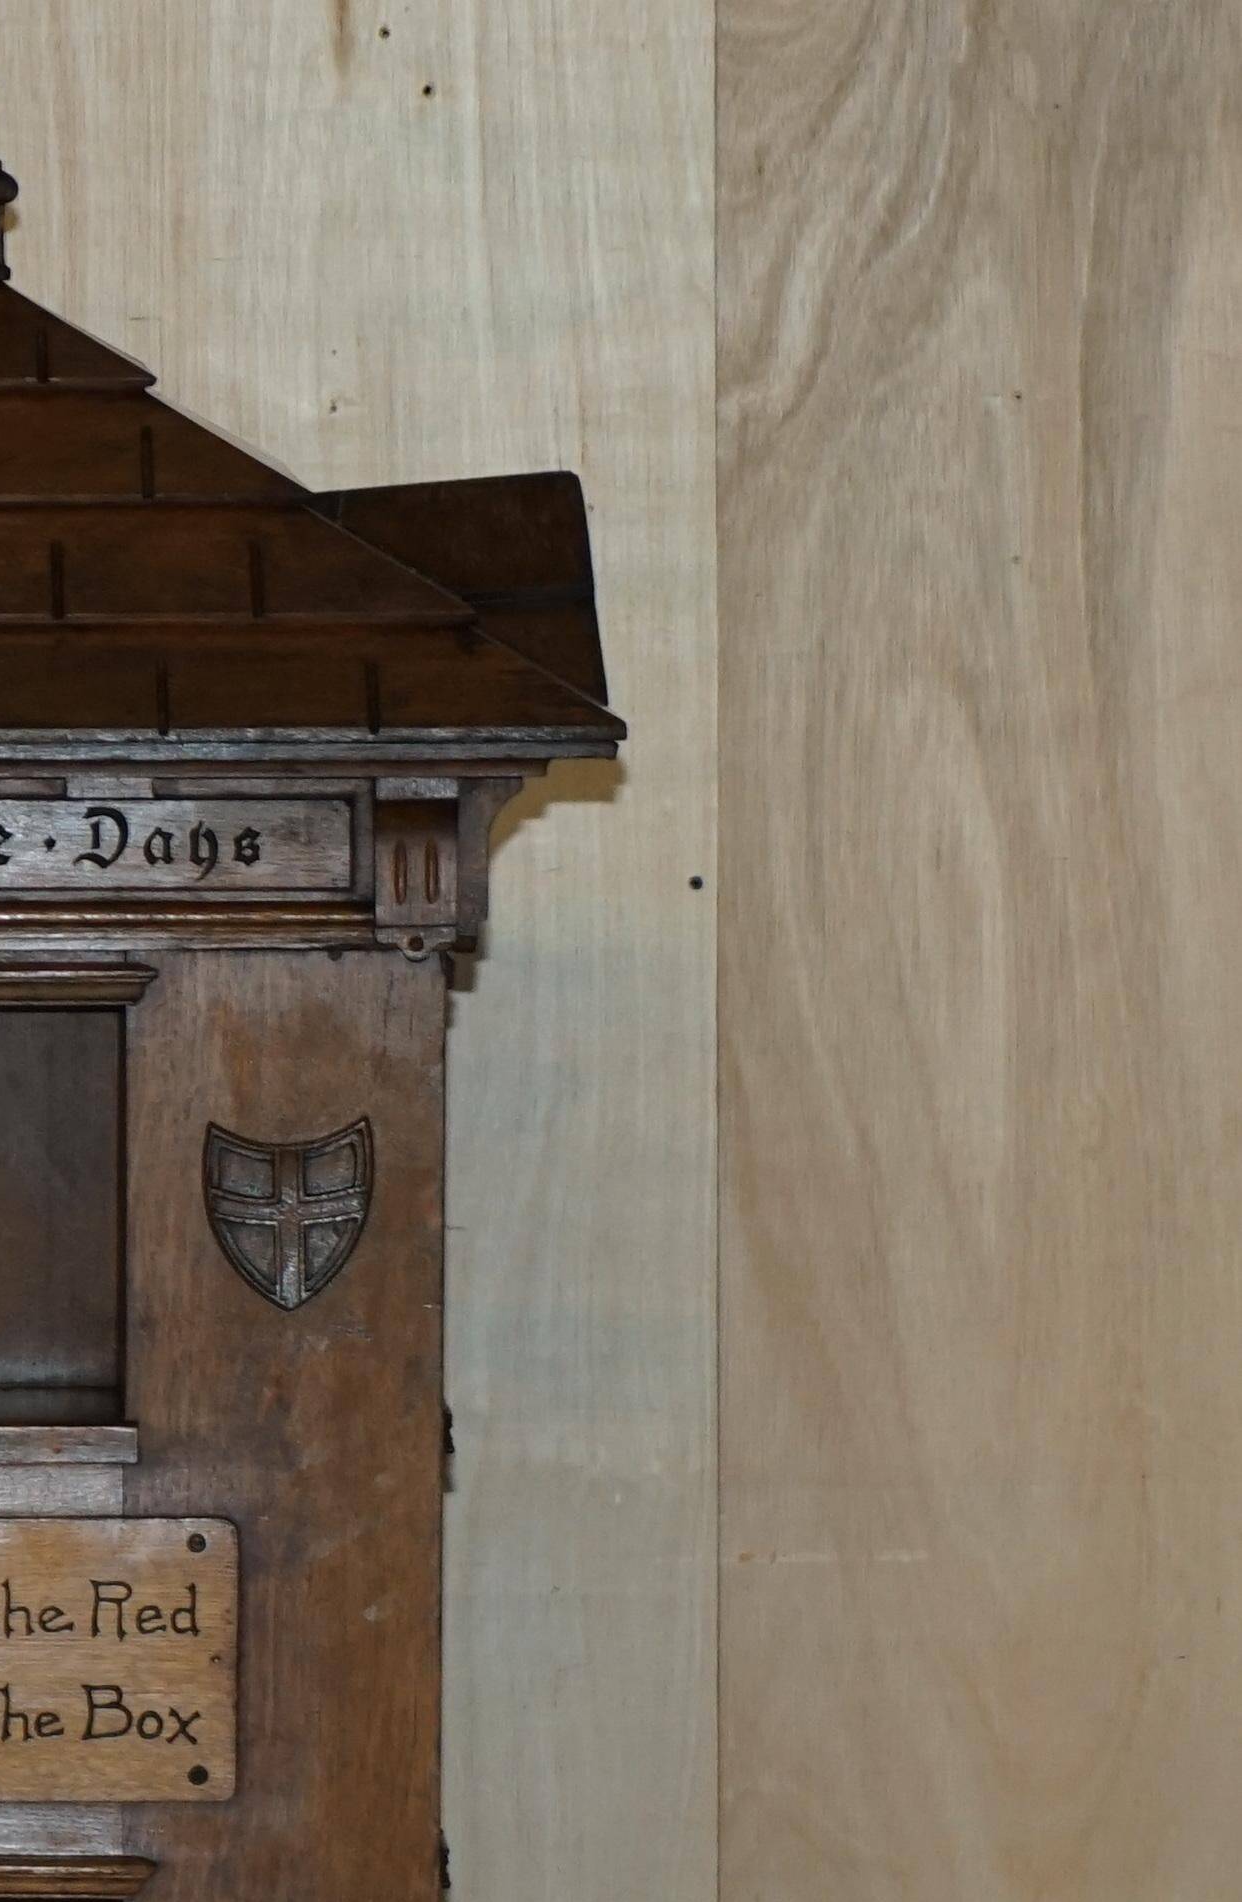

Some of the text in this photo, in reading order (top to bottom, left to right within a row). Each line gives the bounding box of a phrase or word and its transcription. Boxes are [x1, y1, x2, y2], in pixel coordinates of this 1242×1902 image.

[74, 806, 264, 881] Days
[89, 1579, 201, 1641] Red
[81, 1683, 202, 1746] Box
